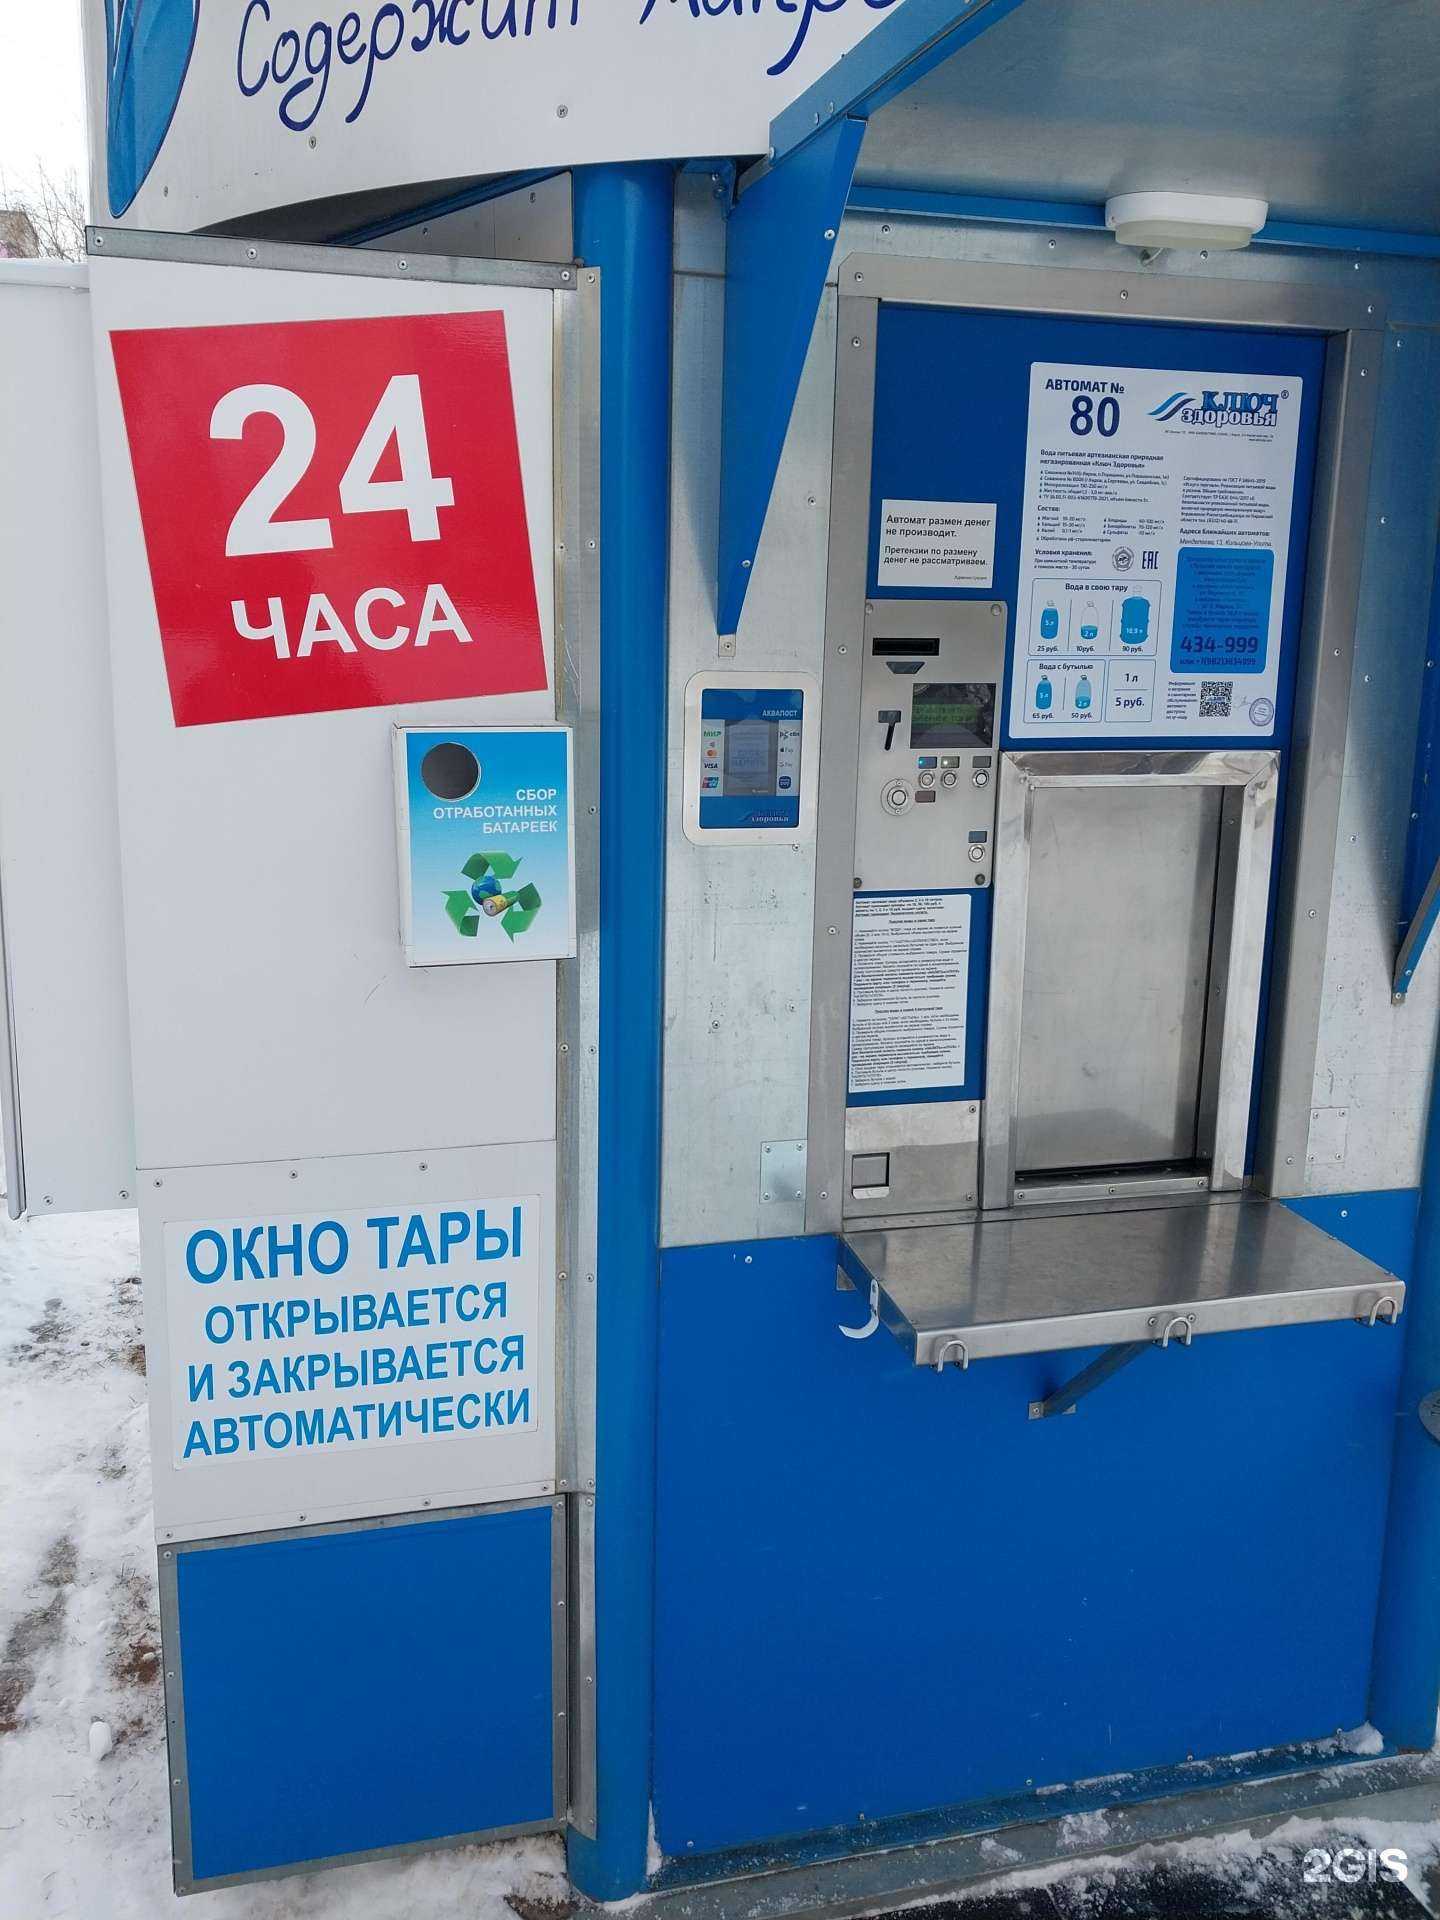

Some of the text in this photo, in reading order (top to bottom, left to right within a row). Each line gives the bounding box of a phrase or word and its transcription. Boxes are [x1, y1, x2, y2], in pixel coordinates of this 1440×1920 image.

[1045, 379, 1125, 393] АВТОМАТ №
[1201, 391, 1279, 413] КЛЮЧ
[1070, 395, 1120, 437] 80
[209, 374, 455, 556] 24
[886, 514, 991, 527] Автомат размен денег
[899, 528, 957, 538] производит.
[884, 545, 929, 555] Претензии
[943, 548, 978, 558] размену
[1034, 548, 1093, 557] Условия хранения:
[883, 556, 988, 566] денег не рассматриваем.
[1111, 585, 1129, 593] тару
[231, 583, 473, 659] ЧАСА
[1045, 645, 1058, 653] руб.
[1179, 635, 1259, 654] 434-999
[1062, 663, 1094, 671] бутылью
[1124, 673, 1138, 683] 1 л
[1115, 696, 1145, 708] 5 руб.
[762, 709, 798, 717] АКВАПОСТ
[1041, 712, 1054, 720] руб.
[1080, 712, 1092, 720] руб.
[516, 788, 557, 801] СБОР
[432, 804, 558, 820] ОТРАБОТАННЫХ
[482, 820, 558, 834] БАТАРЕЕК
[185, 1206, 522, 1284] ОКНО ТАРЫ
[205, 1281, 507, 1344] ОТКРЫВАЕТСЯ
[187, 1334, 525, 1403] И ЗАКРЫВАЕТСЯ
[183, 1387, 530, 1459] АВТОМАТИЧЕСКИ
